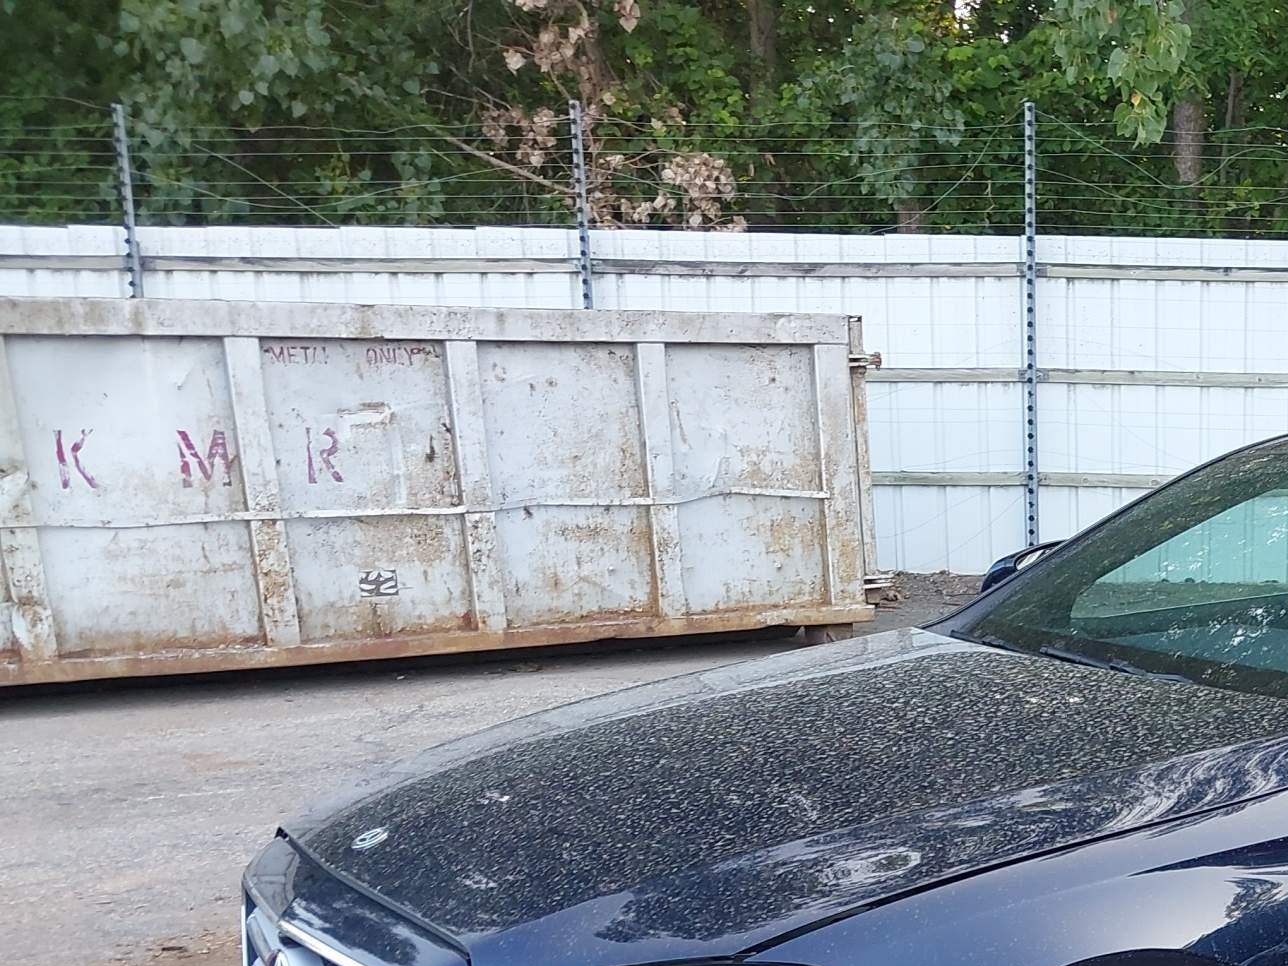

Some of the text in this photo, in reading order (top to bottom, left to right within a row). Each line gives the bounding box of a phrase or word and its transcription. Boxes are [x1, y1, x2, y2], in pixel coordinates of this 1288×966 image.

[53, 427, 344, 489] K M R
